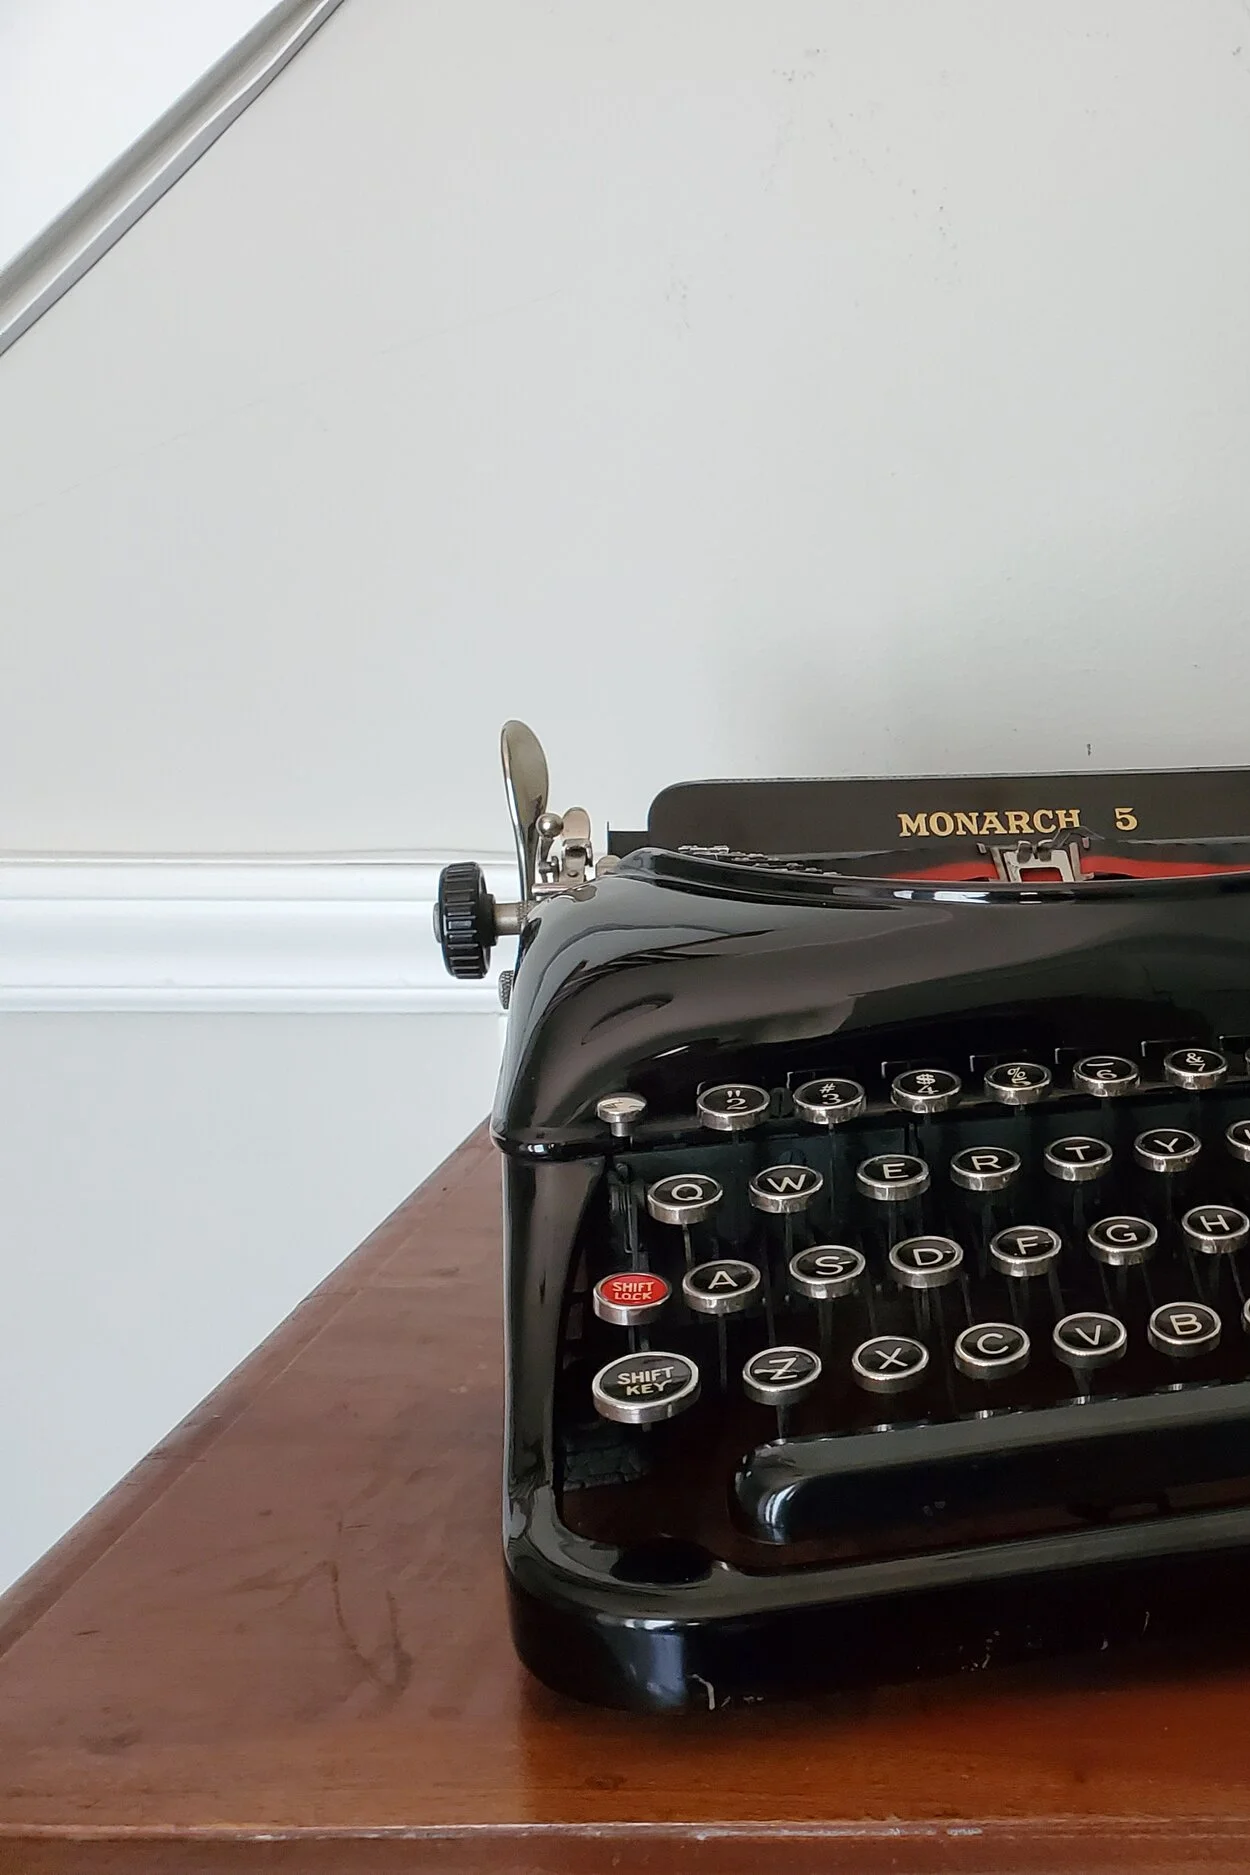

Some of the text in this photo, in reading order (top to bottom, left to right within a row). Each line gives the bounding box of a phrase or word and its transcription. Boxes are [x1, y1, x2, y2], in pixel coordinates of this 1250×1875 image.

[897, 808, 1138, 837] MONARCH 5
[1096, 1069, 1118, 1080] 6
[917, 1084, 939, 1095] 4
[726, 1098, 748, 1110] 2
[822, 1093, 842, 1105] 3
[1064, 1146, 1091, 1161] T
[1153, 1138, 1179, 1153] Y
[882, 1163, 909, 1179] E
[971, 1155, 1002, 1171] R
[671, 1183, 704, 1201] Q
[766, 1174, 809, 1194] W
[1199, 1215, 1230, 1232] H
[1106, 1224, 1138, 1243] G
[1017, 1236, 1039, 1254] F
[815, 1256, 845, 1276] S
[912, 1248, 944, 1266] D
[613, 1282, 654, 1295] SHIFT
[708, 1271, 738, 1290] A
[615, 1291, 652, 1300] LOCK
[1169, 1314, 1203, 1336] B
[976, 1333, 1009, 1355] C
[1074, 1325, 1102, 1346] V
[874, 1348, 908, 1370] X
[618, 1367, 674, 1386] SHIFT
[768, 1357, 798, 1381] Z
[625, 1380, 673, 1396] KEY
